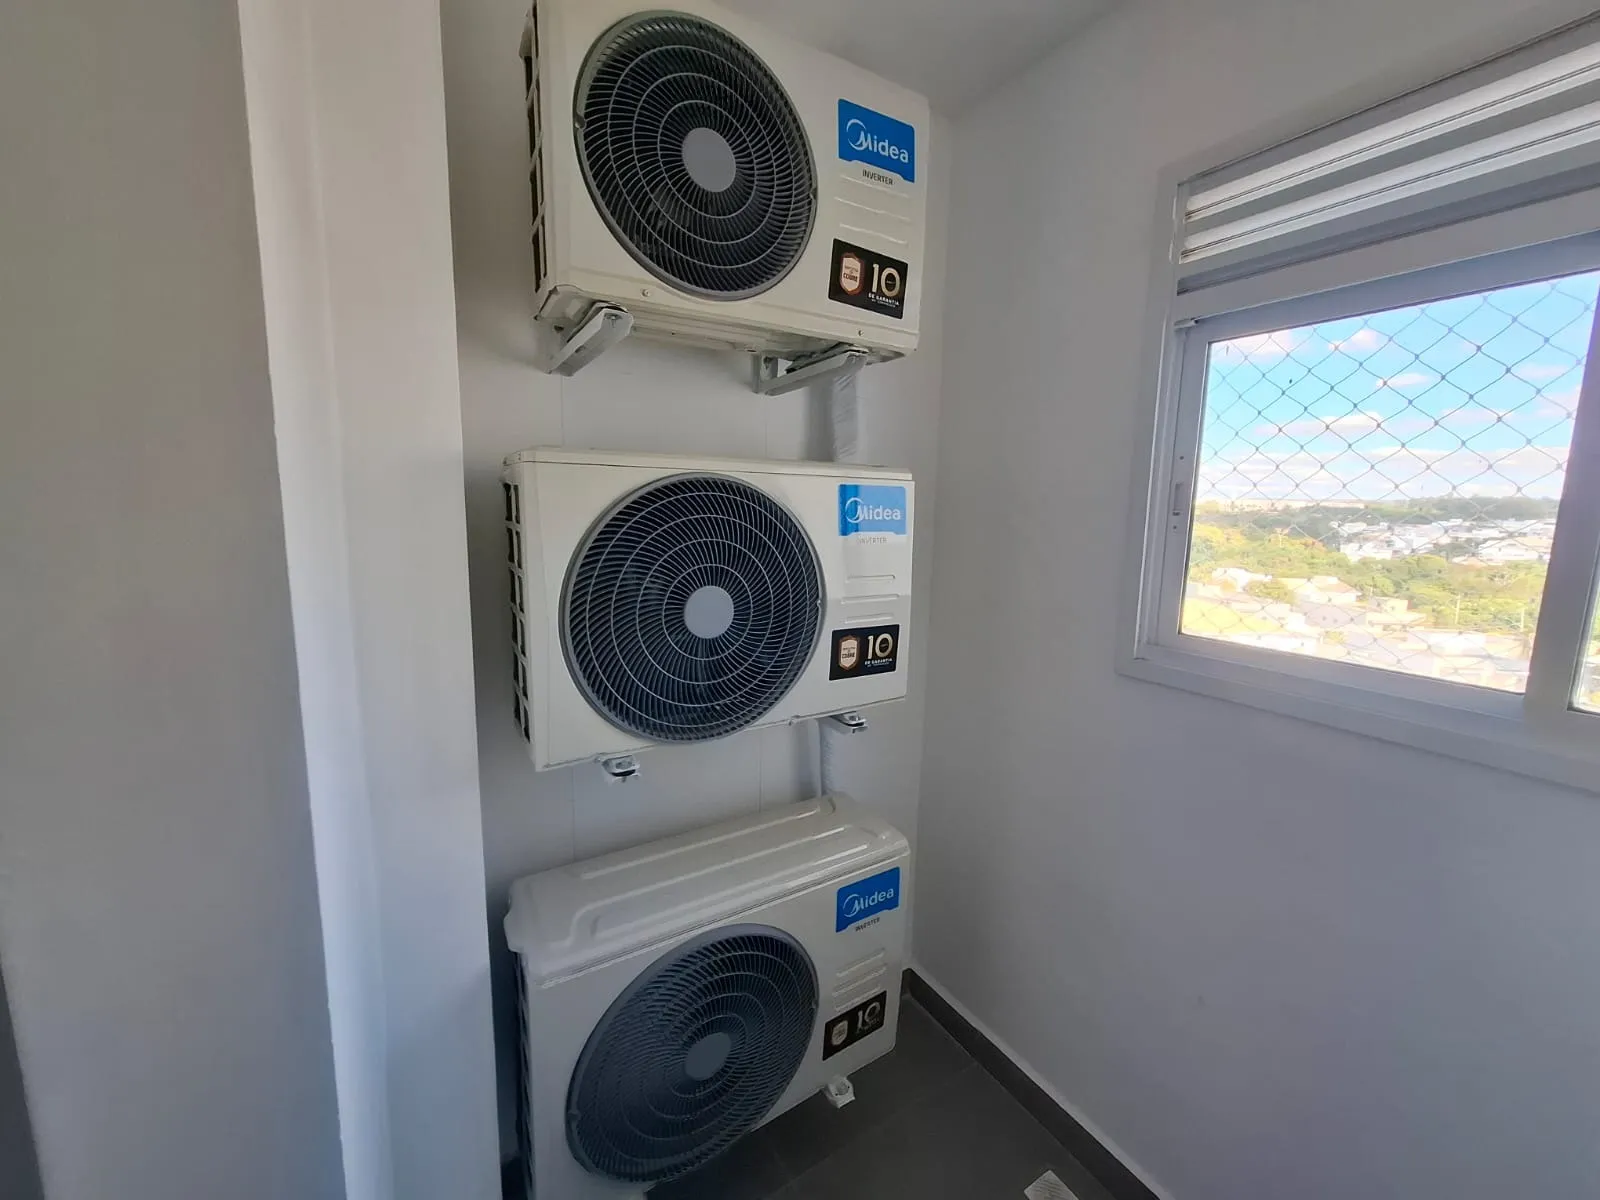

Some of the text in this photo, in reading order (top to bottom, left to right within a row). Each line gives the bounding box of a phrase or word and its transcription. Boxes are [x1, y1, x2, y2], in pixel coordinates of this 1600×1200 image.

[846, 119, 909, 163] Midea
[862, 169, 893, 185] INVERTER
[872, 263, 901, 297] 10
[845, 497, 901, 524] Midea
[867, 633, 893, 660] 10
[843, 888, 894, 918] Midea
[857, 1001, 881, 1029] 10
